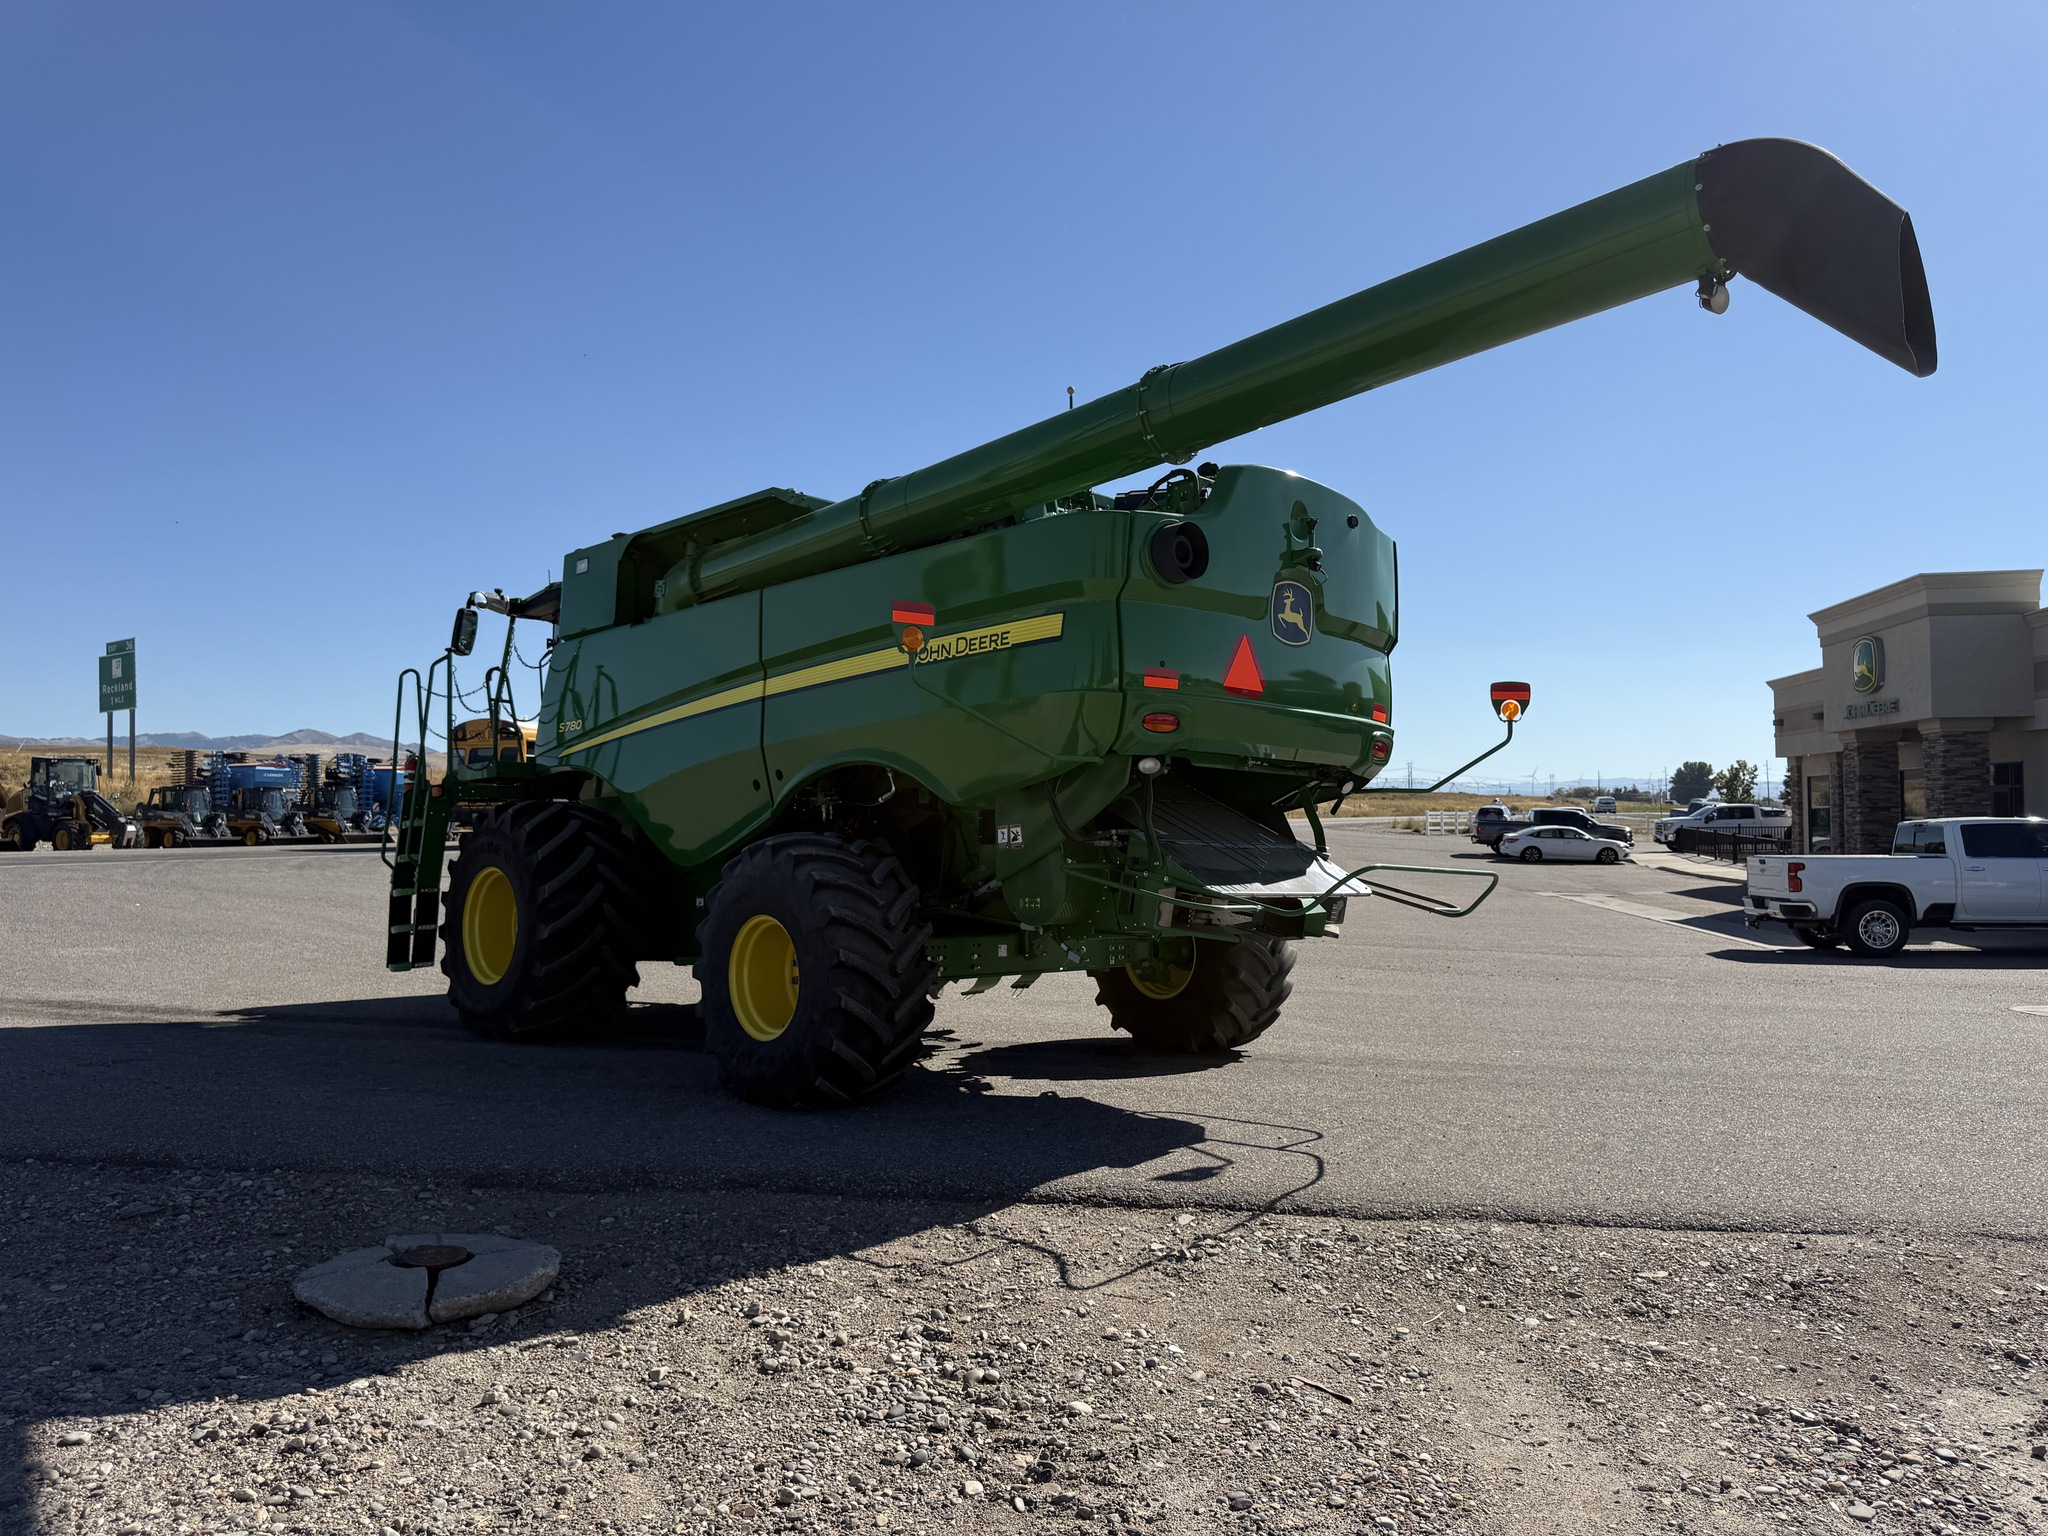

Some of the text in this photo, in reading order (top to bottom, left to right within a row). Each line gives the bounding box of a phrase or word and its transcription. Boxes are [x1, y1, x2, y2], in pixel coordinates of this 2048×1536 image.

[108, 640, 134, 653] EXIT 36
[918, 631, 1011, 662] OHN DEERE
[102, 681, 133, 694] Rockland
[114, 696, 125, 704] MILE
